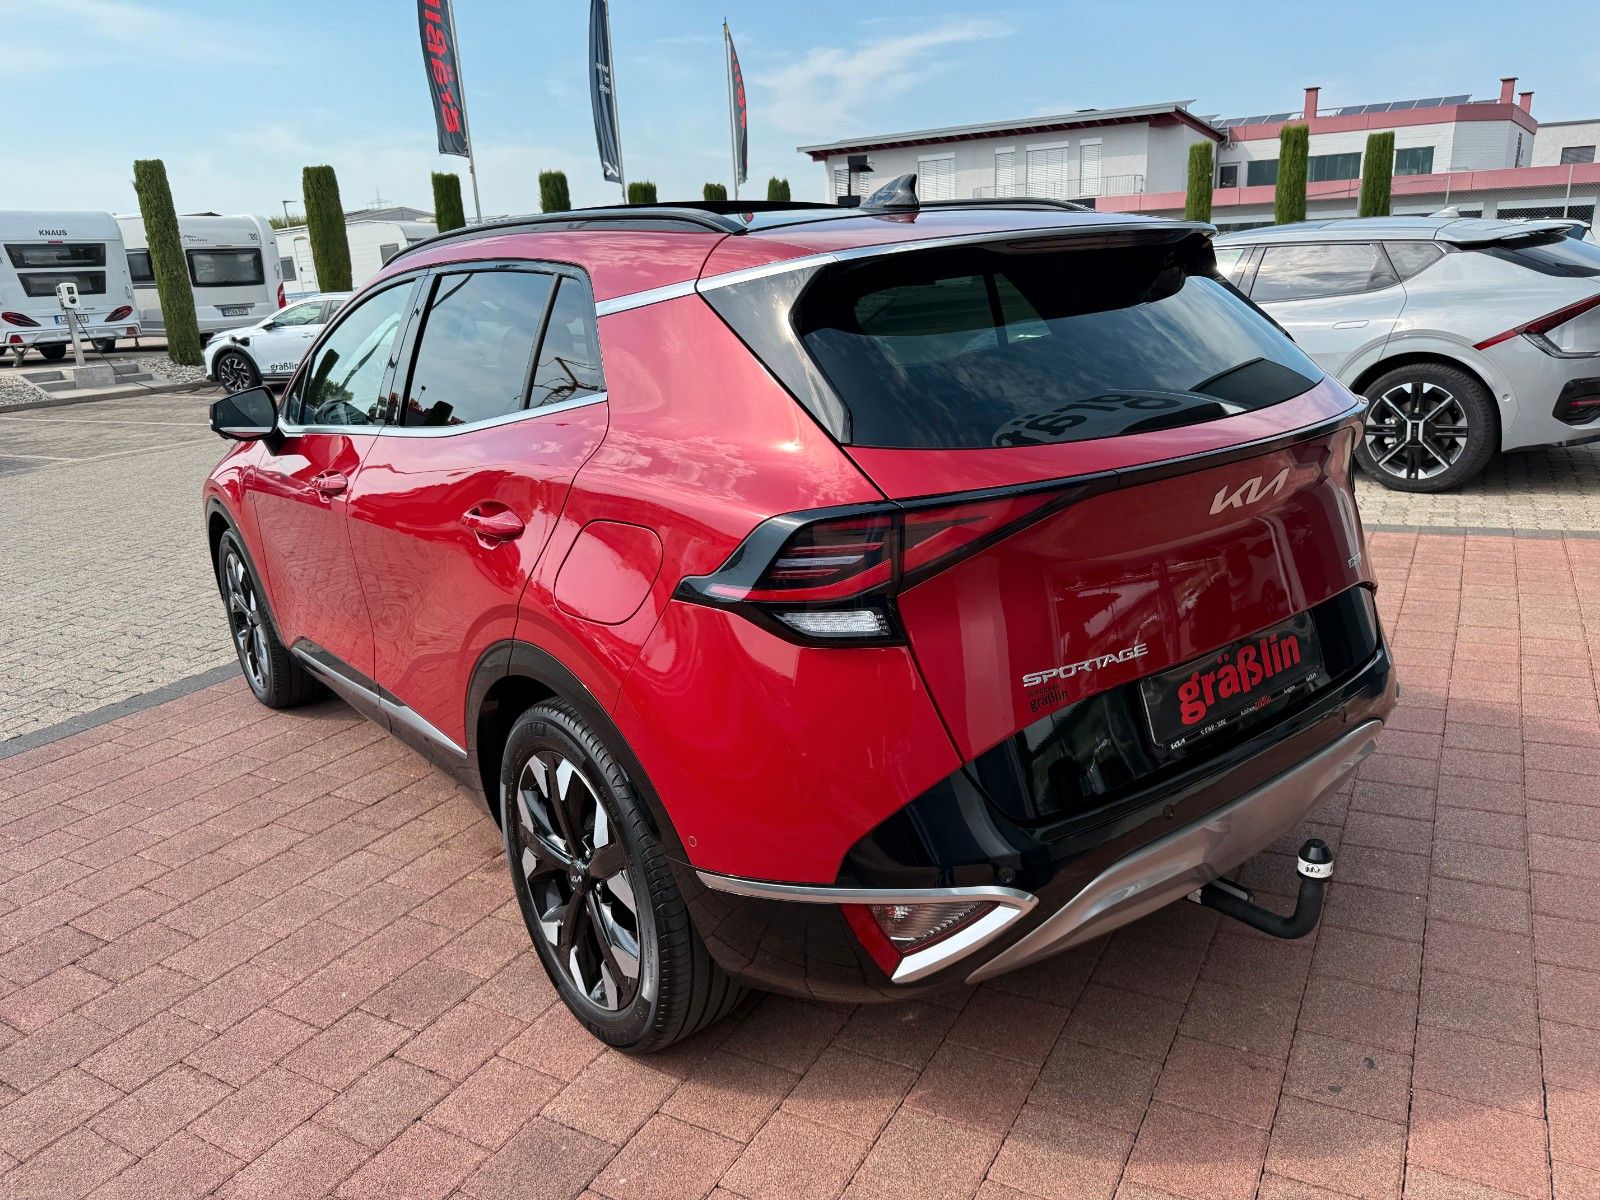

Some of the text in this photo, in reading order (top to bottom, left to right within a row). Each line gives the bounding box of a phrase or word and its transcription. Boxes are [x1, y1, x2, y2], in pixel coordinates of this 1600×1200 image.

[1209, 466, 1290, 515] KIA
[1022, 643, 1149, 688] SPORTAGE
[1177, 633, 1301, 726] gräßlin
